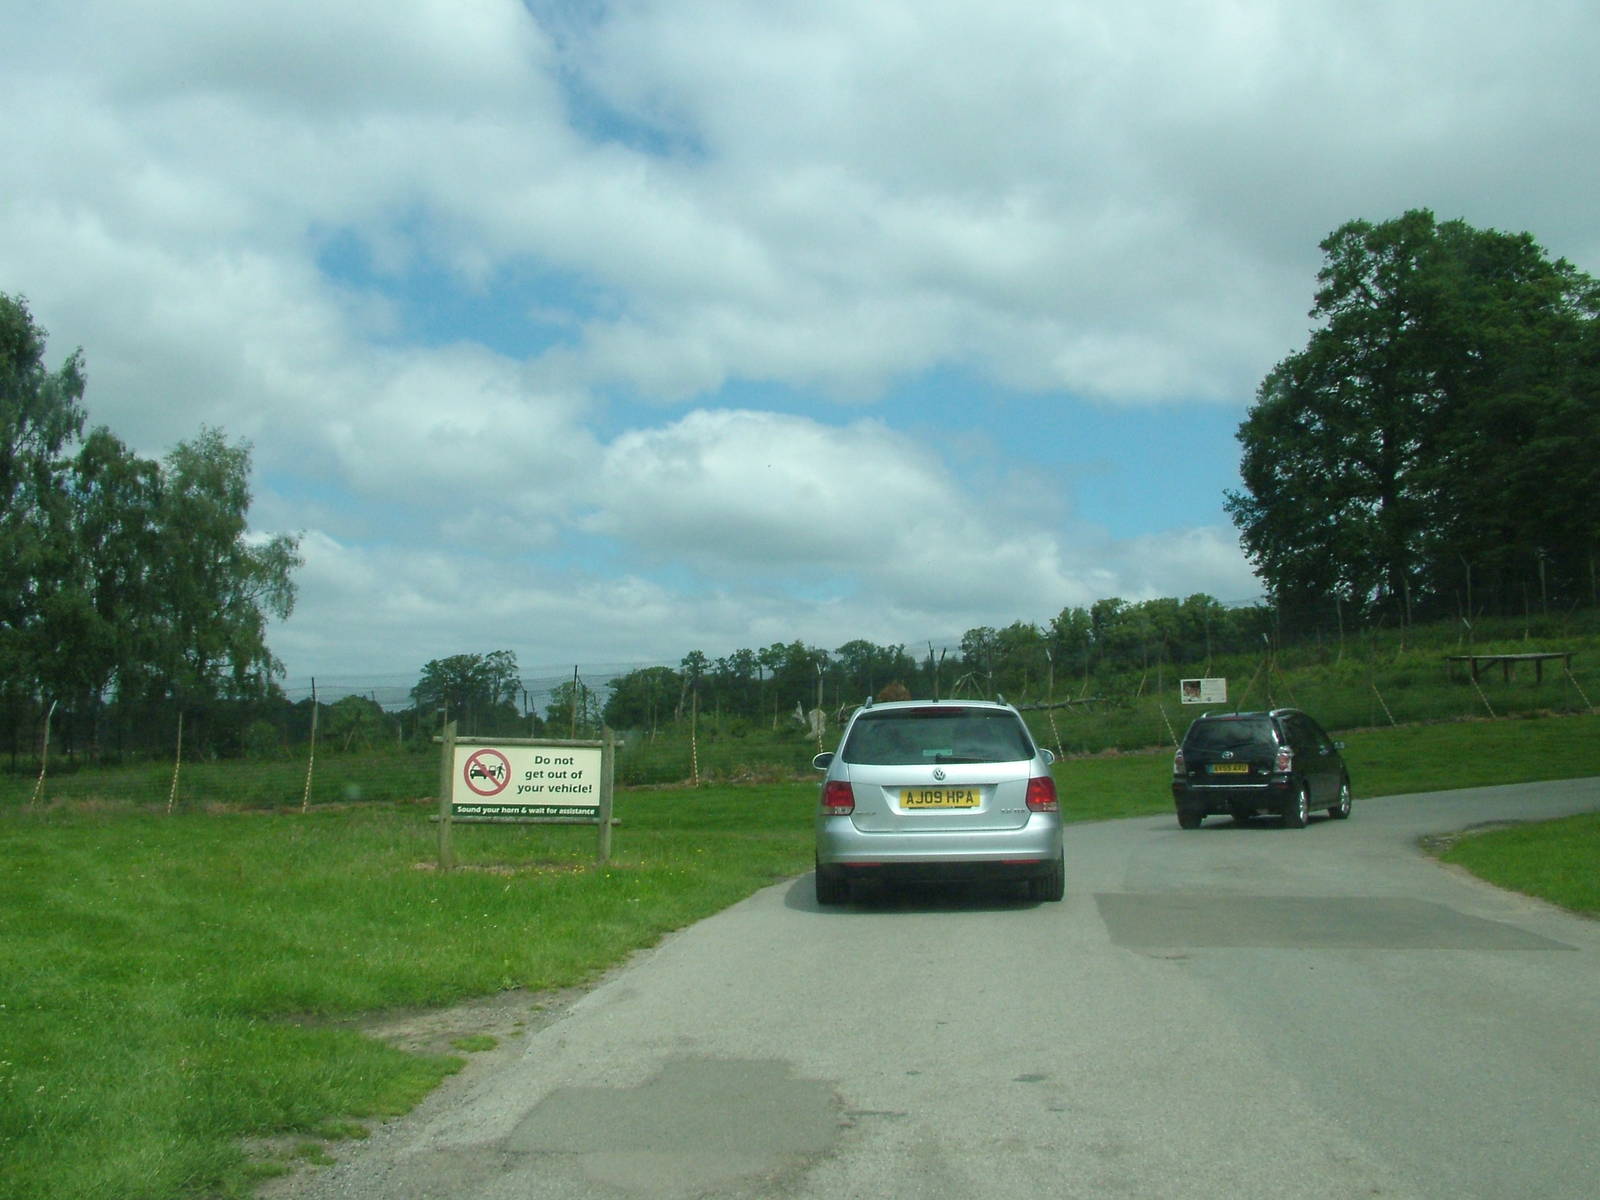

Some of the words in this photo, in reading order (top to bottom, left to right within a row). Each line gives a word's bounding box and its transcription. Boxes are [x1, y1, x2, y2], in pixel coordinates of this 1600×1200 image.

[535, 756, 550, 765] Do
[554, 756, 574, 765] not
[525, 770, 544, 781] get
[548, 771, 567, 780] out
[571, 770, 583, 780] of
[517, 785, 544, 795] your
[548, 784, 592, 794] vehicle!
[906, 791, 943, 804] AJ09
[946, 791, 974, 803] HPA
[457, 806, 481, 814] Sound
[482, 807, 500, 815] your
